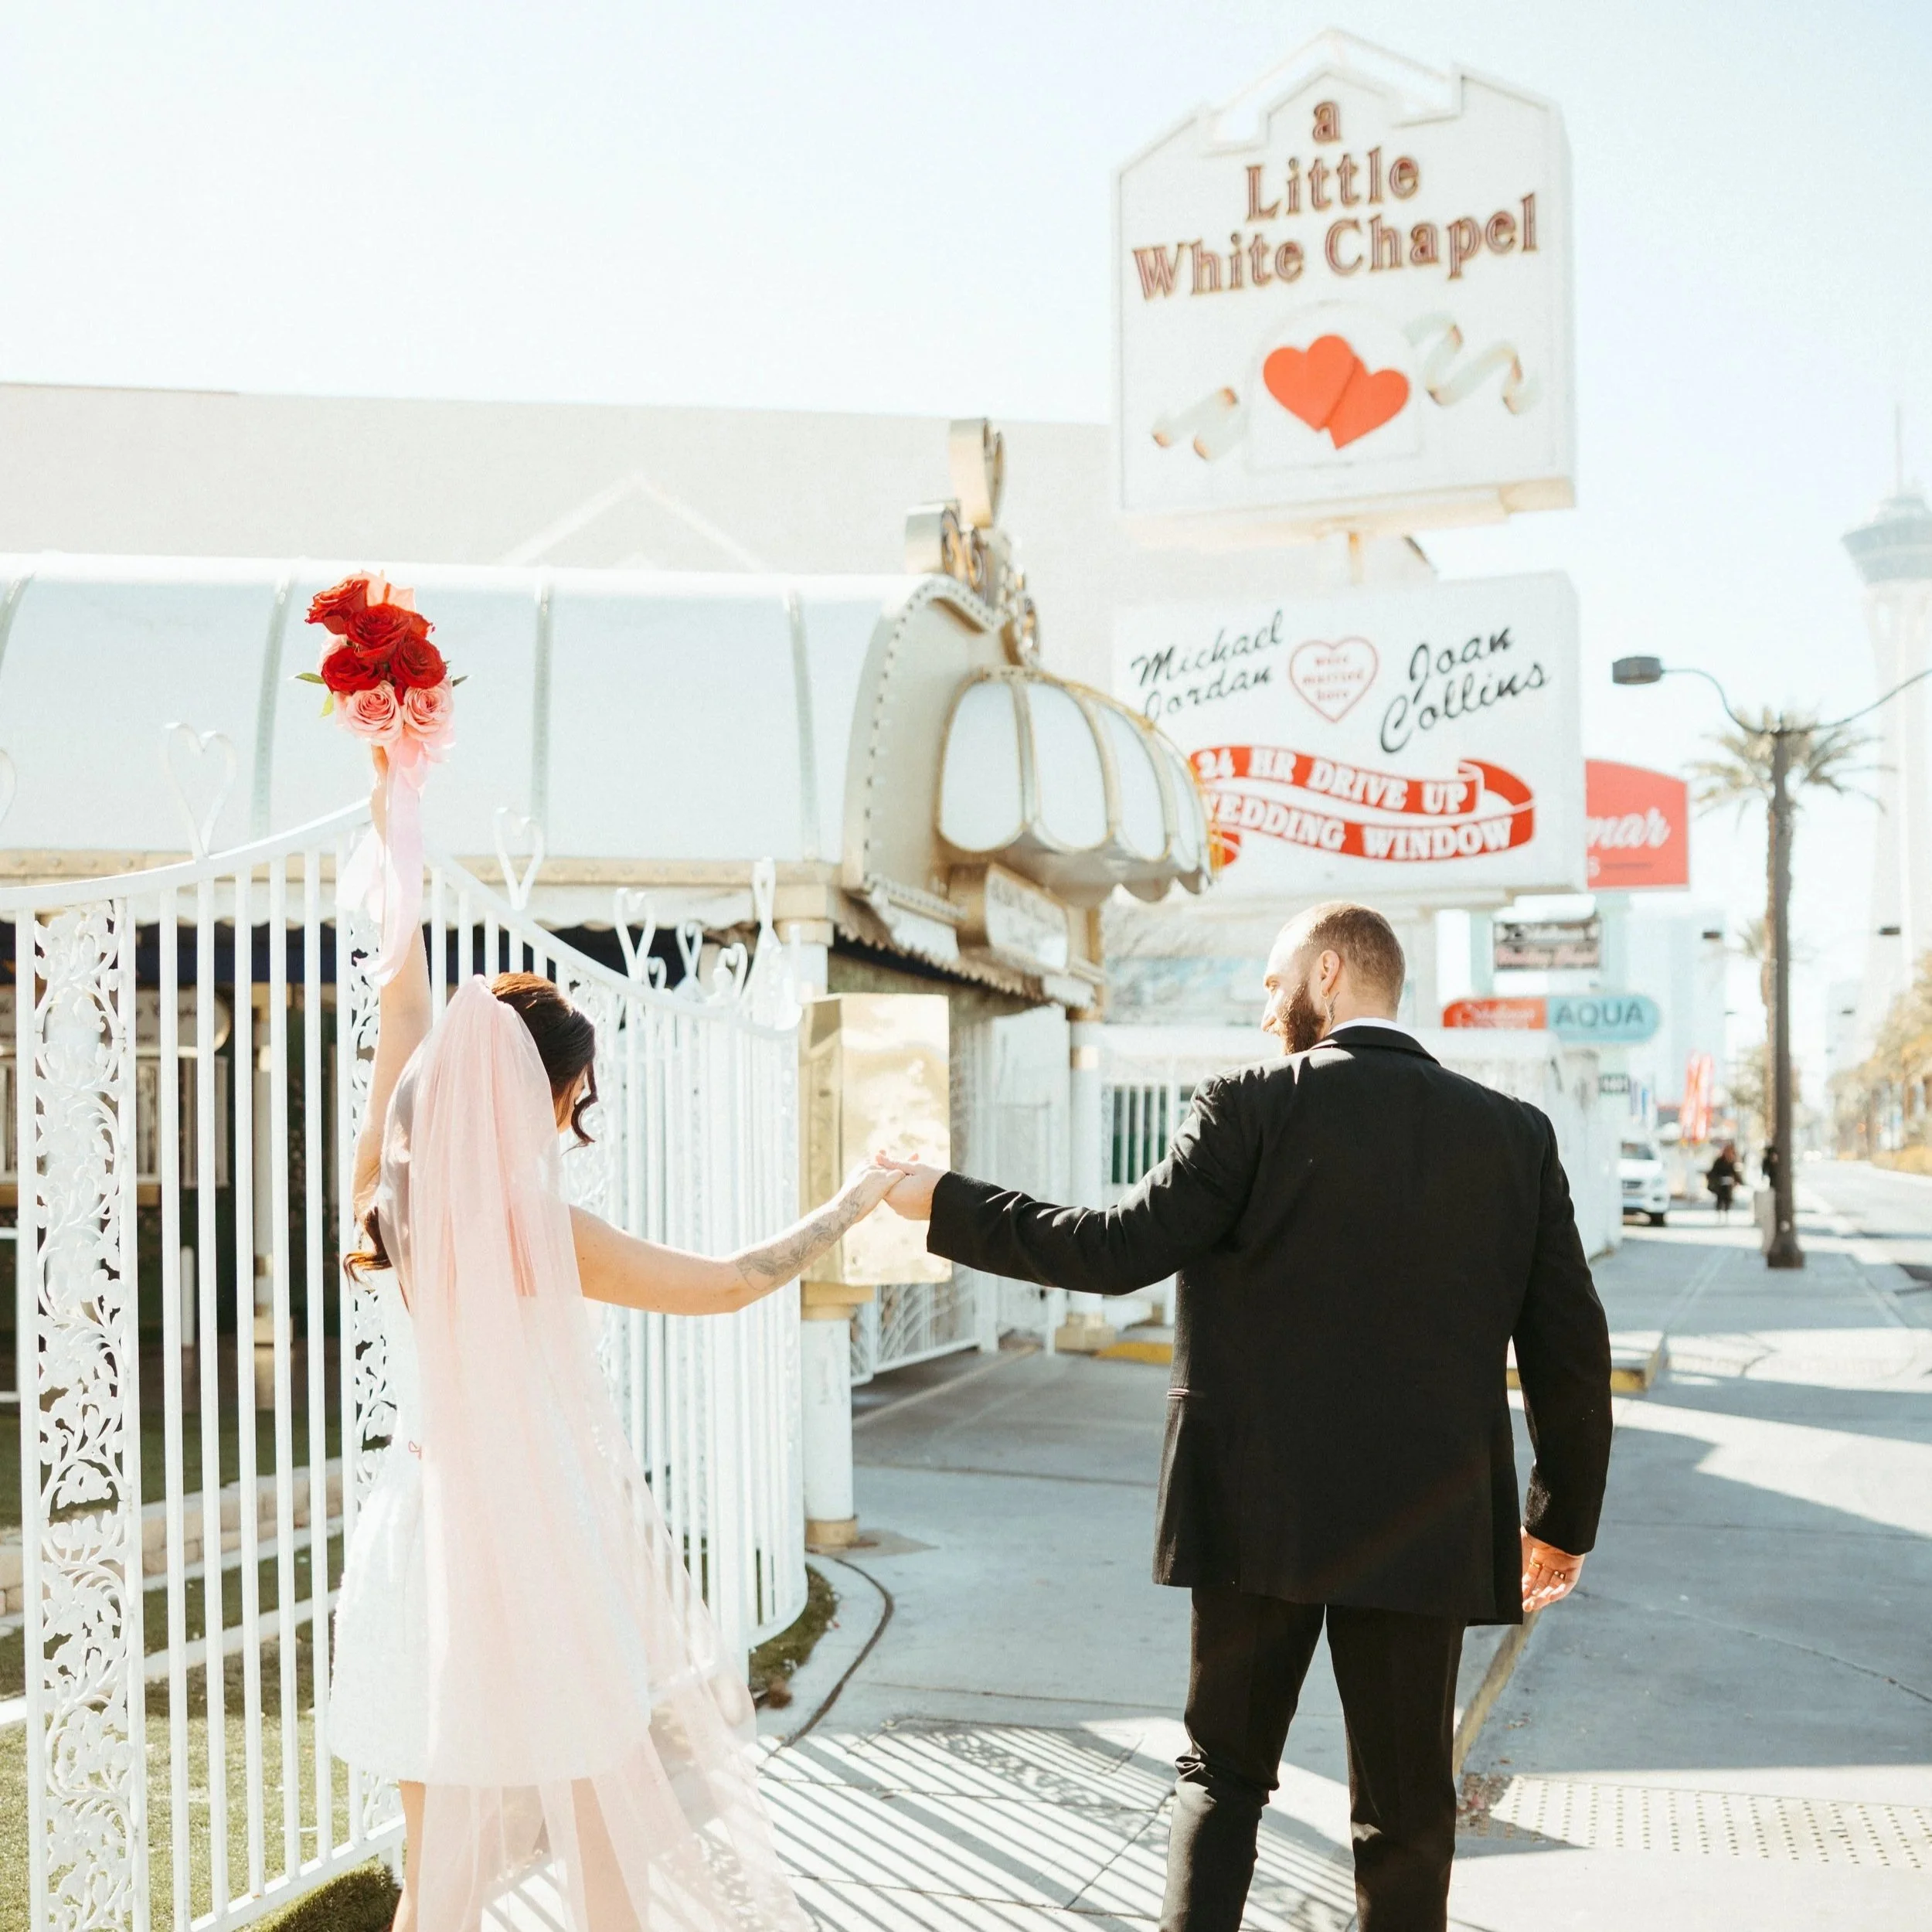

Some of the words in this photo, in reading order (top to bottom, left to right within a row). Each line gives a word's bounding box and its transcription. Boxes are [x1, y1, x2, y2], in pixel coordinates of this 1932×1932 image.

[1312, 100, 1341, 143] a
[1246, 145, 1420, 223] Little
[1133, 231, 1306, 301] White
[1324, 192, 1539, 281] Chapel
[1131, 608, 1284, 686] Michael
[1409, 627, 1515, 705] Joan
[1144, 664, 1274, 722] Jordan
[1379, 662, 1551, 754] Collins
[1197, 750, 1236, 779] 24
[1249, 747, 1298, 783] HR
[1311, 761, 1409, 811] DRIVE
[1421, 781, 1468, 815] UP
[1362, 817, 1514, 860] WINDOW
[1555, 1002, 1644, 1027] AQUA
